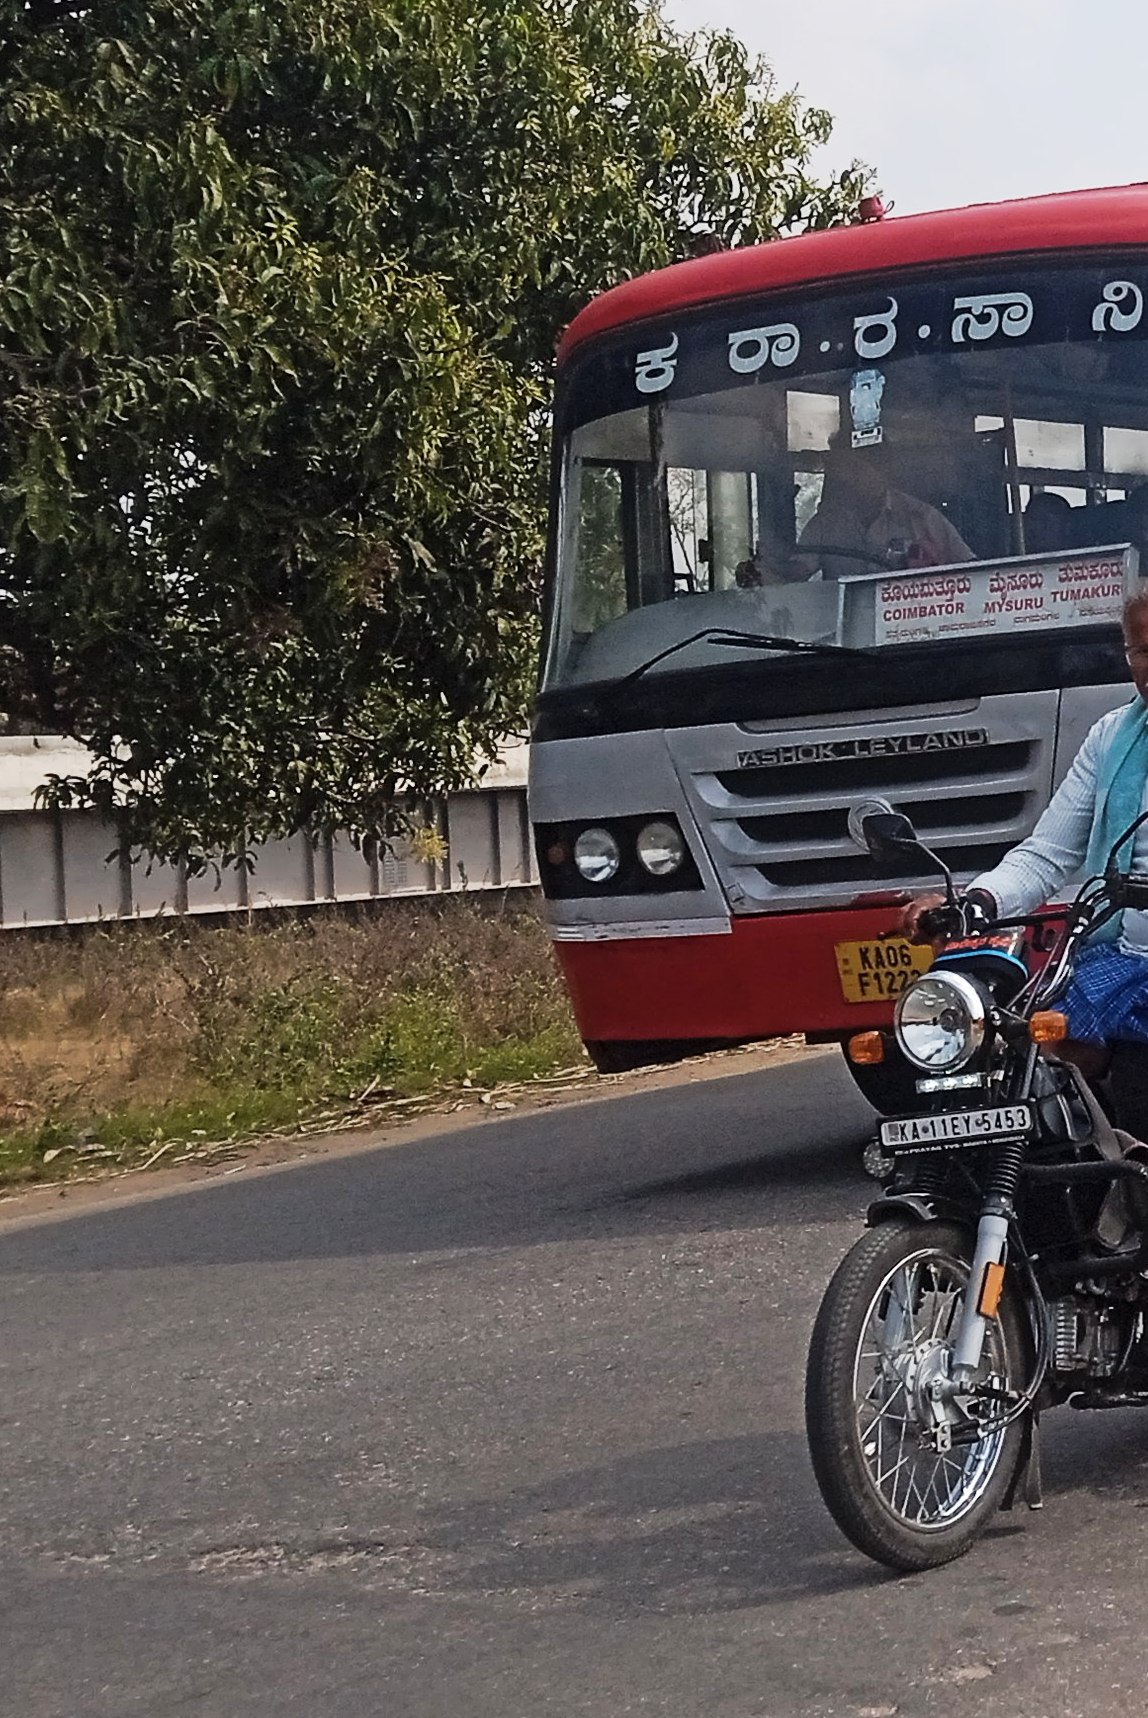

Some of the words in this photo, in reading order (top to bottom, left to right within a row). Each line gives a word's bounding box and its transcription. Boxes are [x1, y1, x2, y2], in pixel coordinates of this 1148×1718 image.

[883, 602, 965, 622] COIMBATOR
[984, 597, 1044, 614] MYSURU
[1050, 584, 1125, 602] TUMAKUR
[742, 743, 836, 768] ASHOK
[854, 729, 984, 756] LEYLAND
[859, 945, 912, 970] KA06
